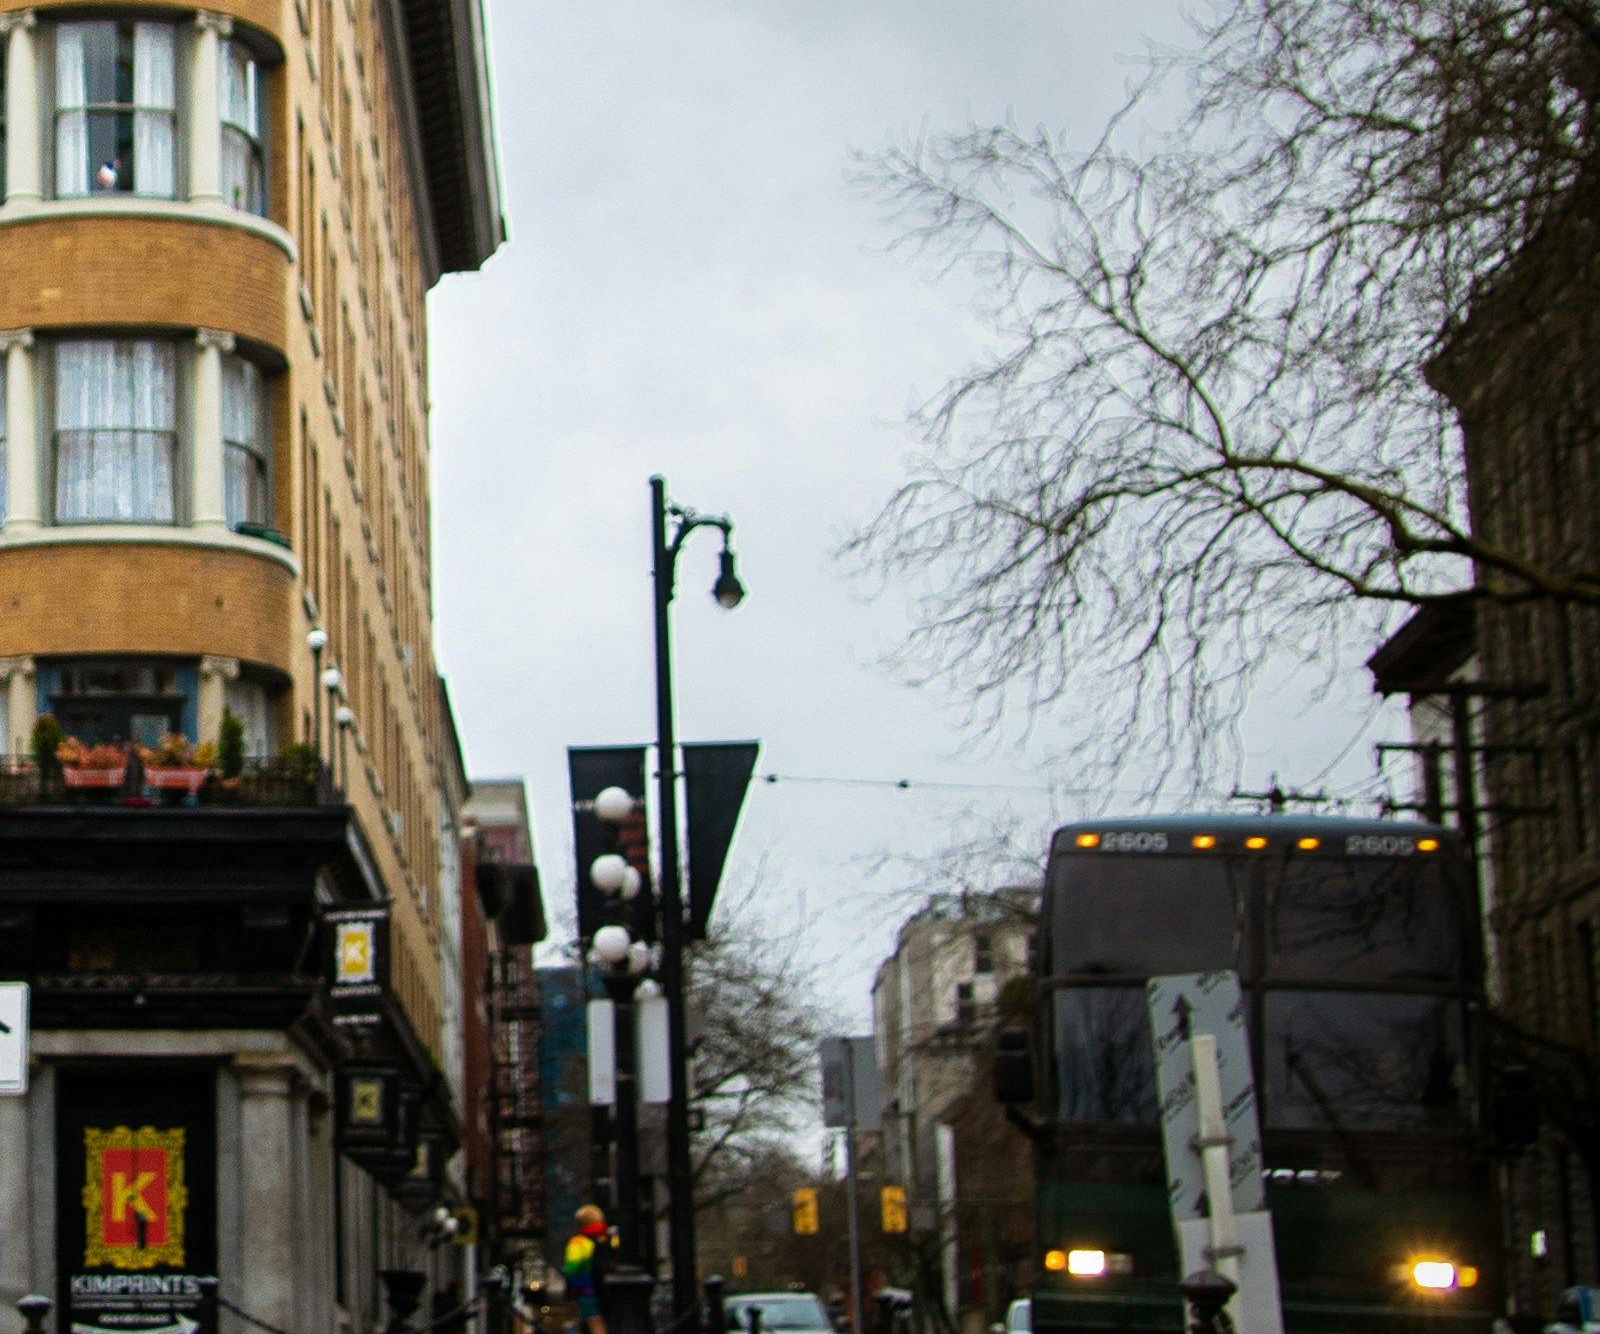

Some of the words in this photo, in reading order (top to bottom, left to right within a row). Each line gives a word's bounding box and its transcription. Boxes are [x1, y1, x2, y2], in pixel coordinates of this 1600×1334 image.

[1101, 832, 1168, 851] 2605
[1346, 835, 1414, 855] 2605
[345, 941, 367, 964] K
[111, 1170, 159, 1223] K
[70, 1274, 200, 1294] KIMPRINTS
